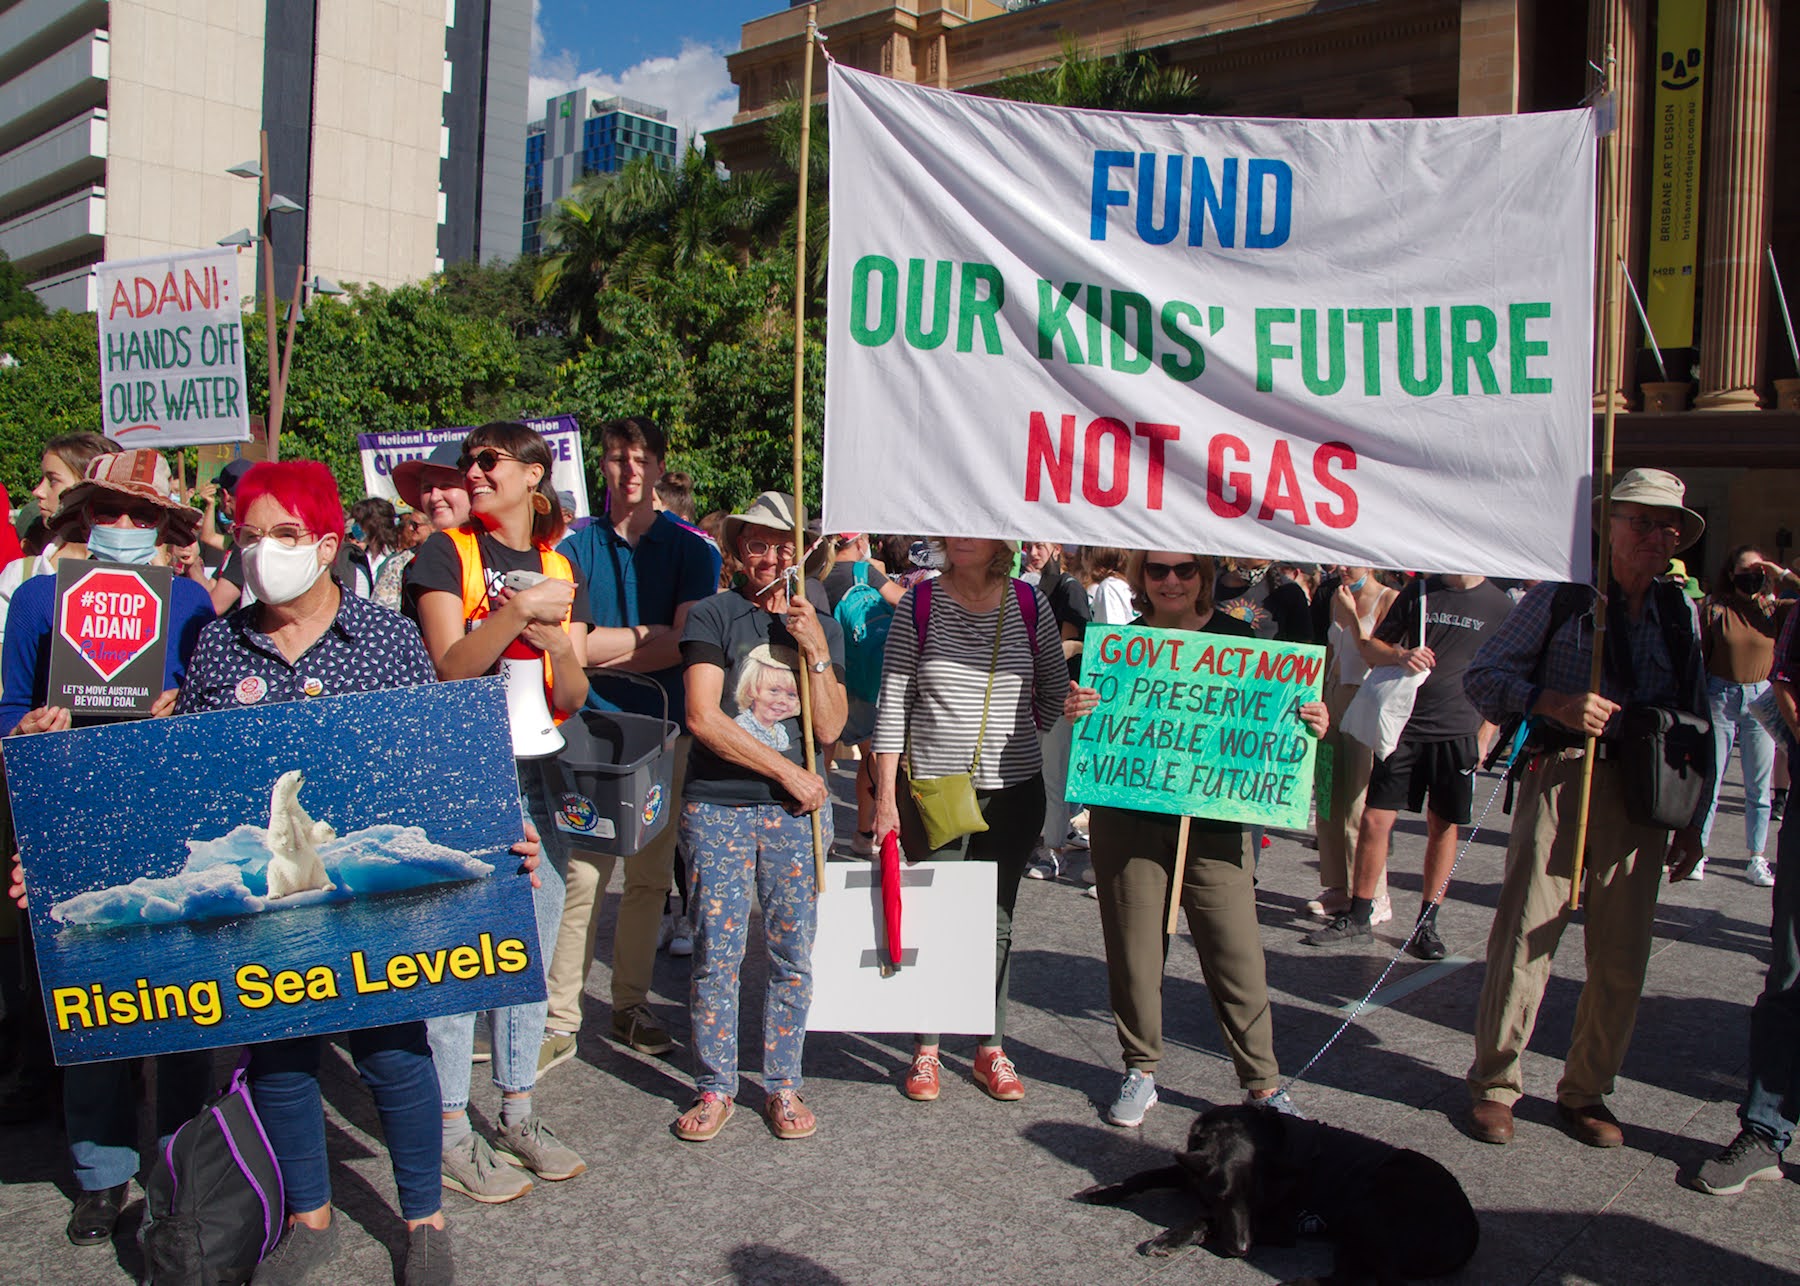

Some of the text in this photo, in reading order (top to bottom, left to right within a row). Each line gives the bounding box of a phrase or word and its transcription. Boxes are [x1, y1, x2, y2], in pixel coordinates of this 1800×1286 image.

[1660, 104, 1675, 242] BRISBANE ART DESIGN
[1682, 102, 1696, 240] brisbaneartdesign.com.au
[1089, 148, 1294, 250] FUND
[109, 266, 229, 320] ADANI:
[107, 323, 239, 372] HANDS OFF
[850, 254, 1553, 397] OUR KIDS' FUTURE
[109, 377, 240, 425] OUR WATER
[377, 433, 424, 445] National
[426, 431, 469, 443] Tertiary
[1023, 410, 1358, 530] NOT GAS
[80, 590, 146, 617] #STOP
[80, 615, 142, 641] ADANI
[80, 639, 138, 662] Palmer
[1192, 645, 1254, 679] ACT
[1254, 651, 1323, 687] NOW
[62, 684, 149, 697] LET'S MOVE AUSTRALIA
[74, 695, 136, 708] BEYOND COAL
[1087, 672, 1301, 725] TO PRESERVE A
[1078, 712, 1309, 764] LIVEABLE WORLD
[1093, 754, 1181, 794] VIABLE
[1187, 765, 1297, 806] FUTURE
[51, 932, 529, 1032] Rising Sea Levels
